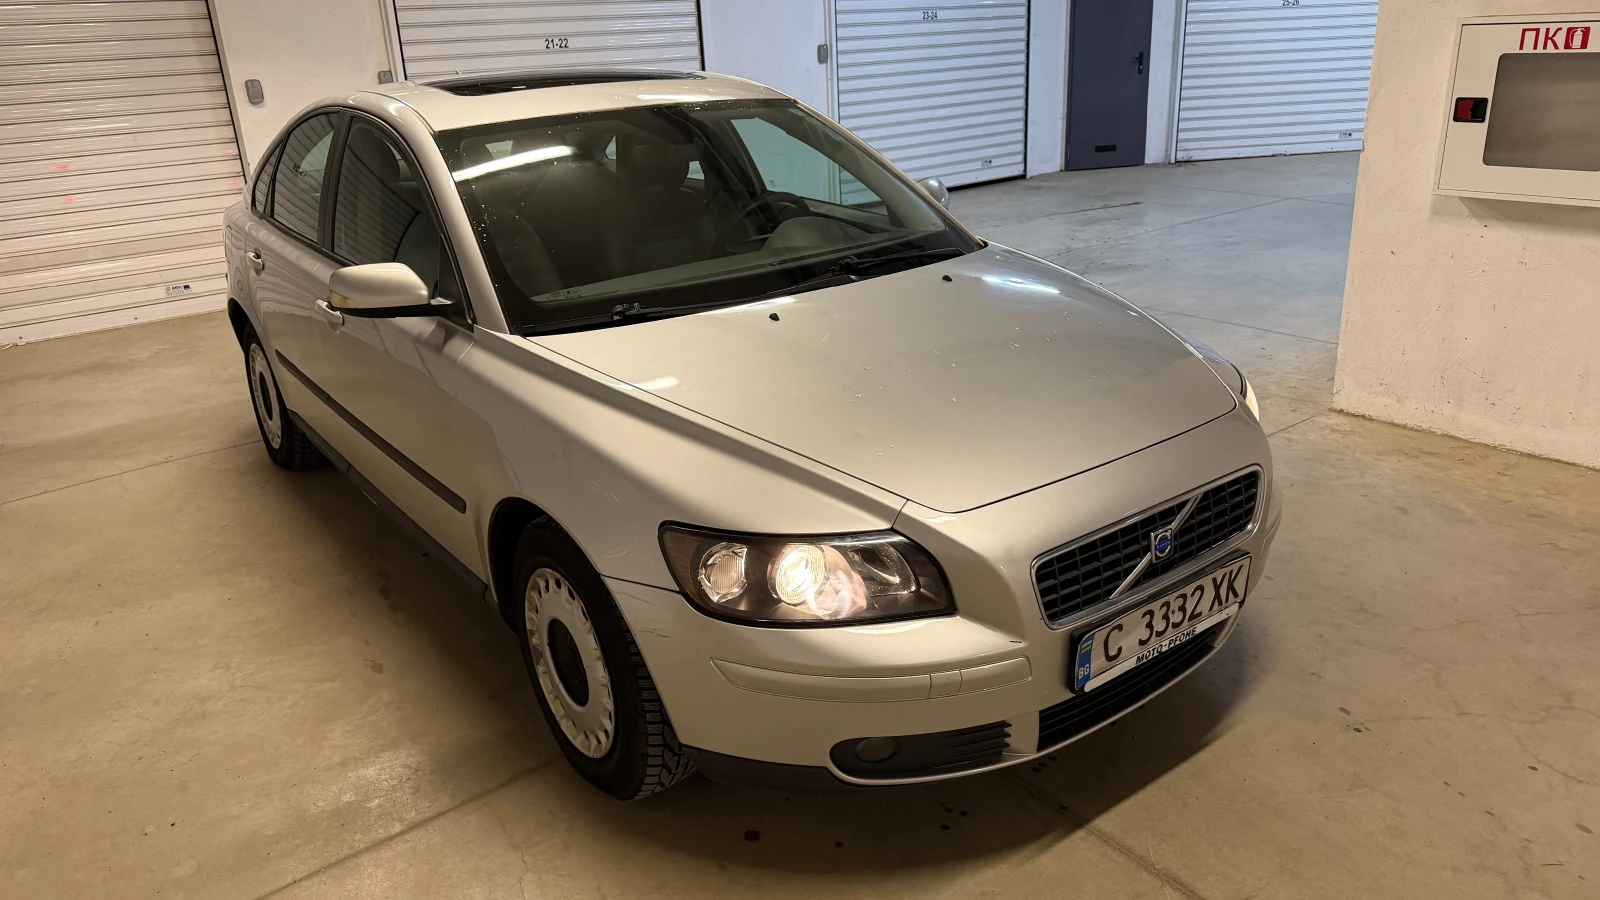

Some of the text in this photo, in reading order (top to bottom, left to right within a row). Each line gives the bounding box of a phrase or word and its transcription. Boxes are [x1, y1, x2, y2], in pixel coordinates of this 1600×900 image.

[922, 11, 938, 20] 23-24
[544, 38, 569, 49] 21-22
[1519, 27, 1562, 50] ПК
[1103, 564, 1244, 662] C 3332 XK
[1135, 626, 1197, 665] MOTO-PFOHE
[1078, 663, 1090, 679] BG
